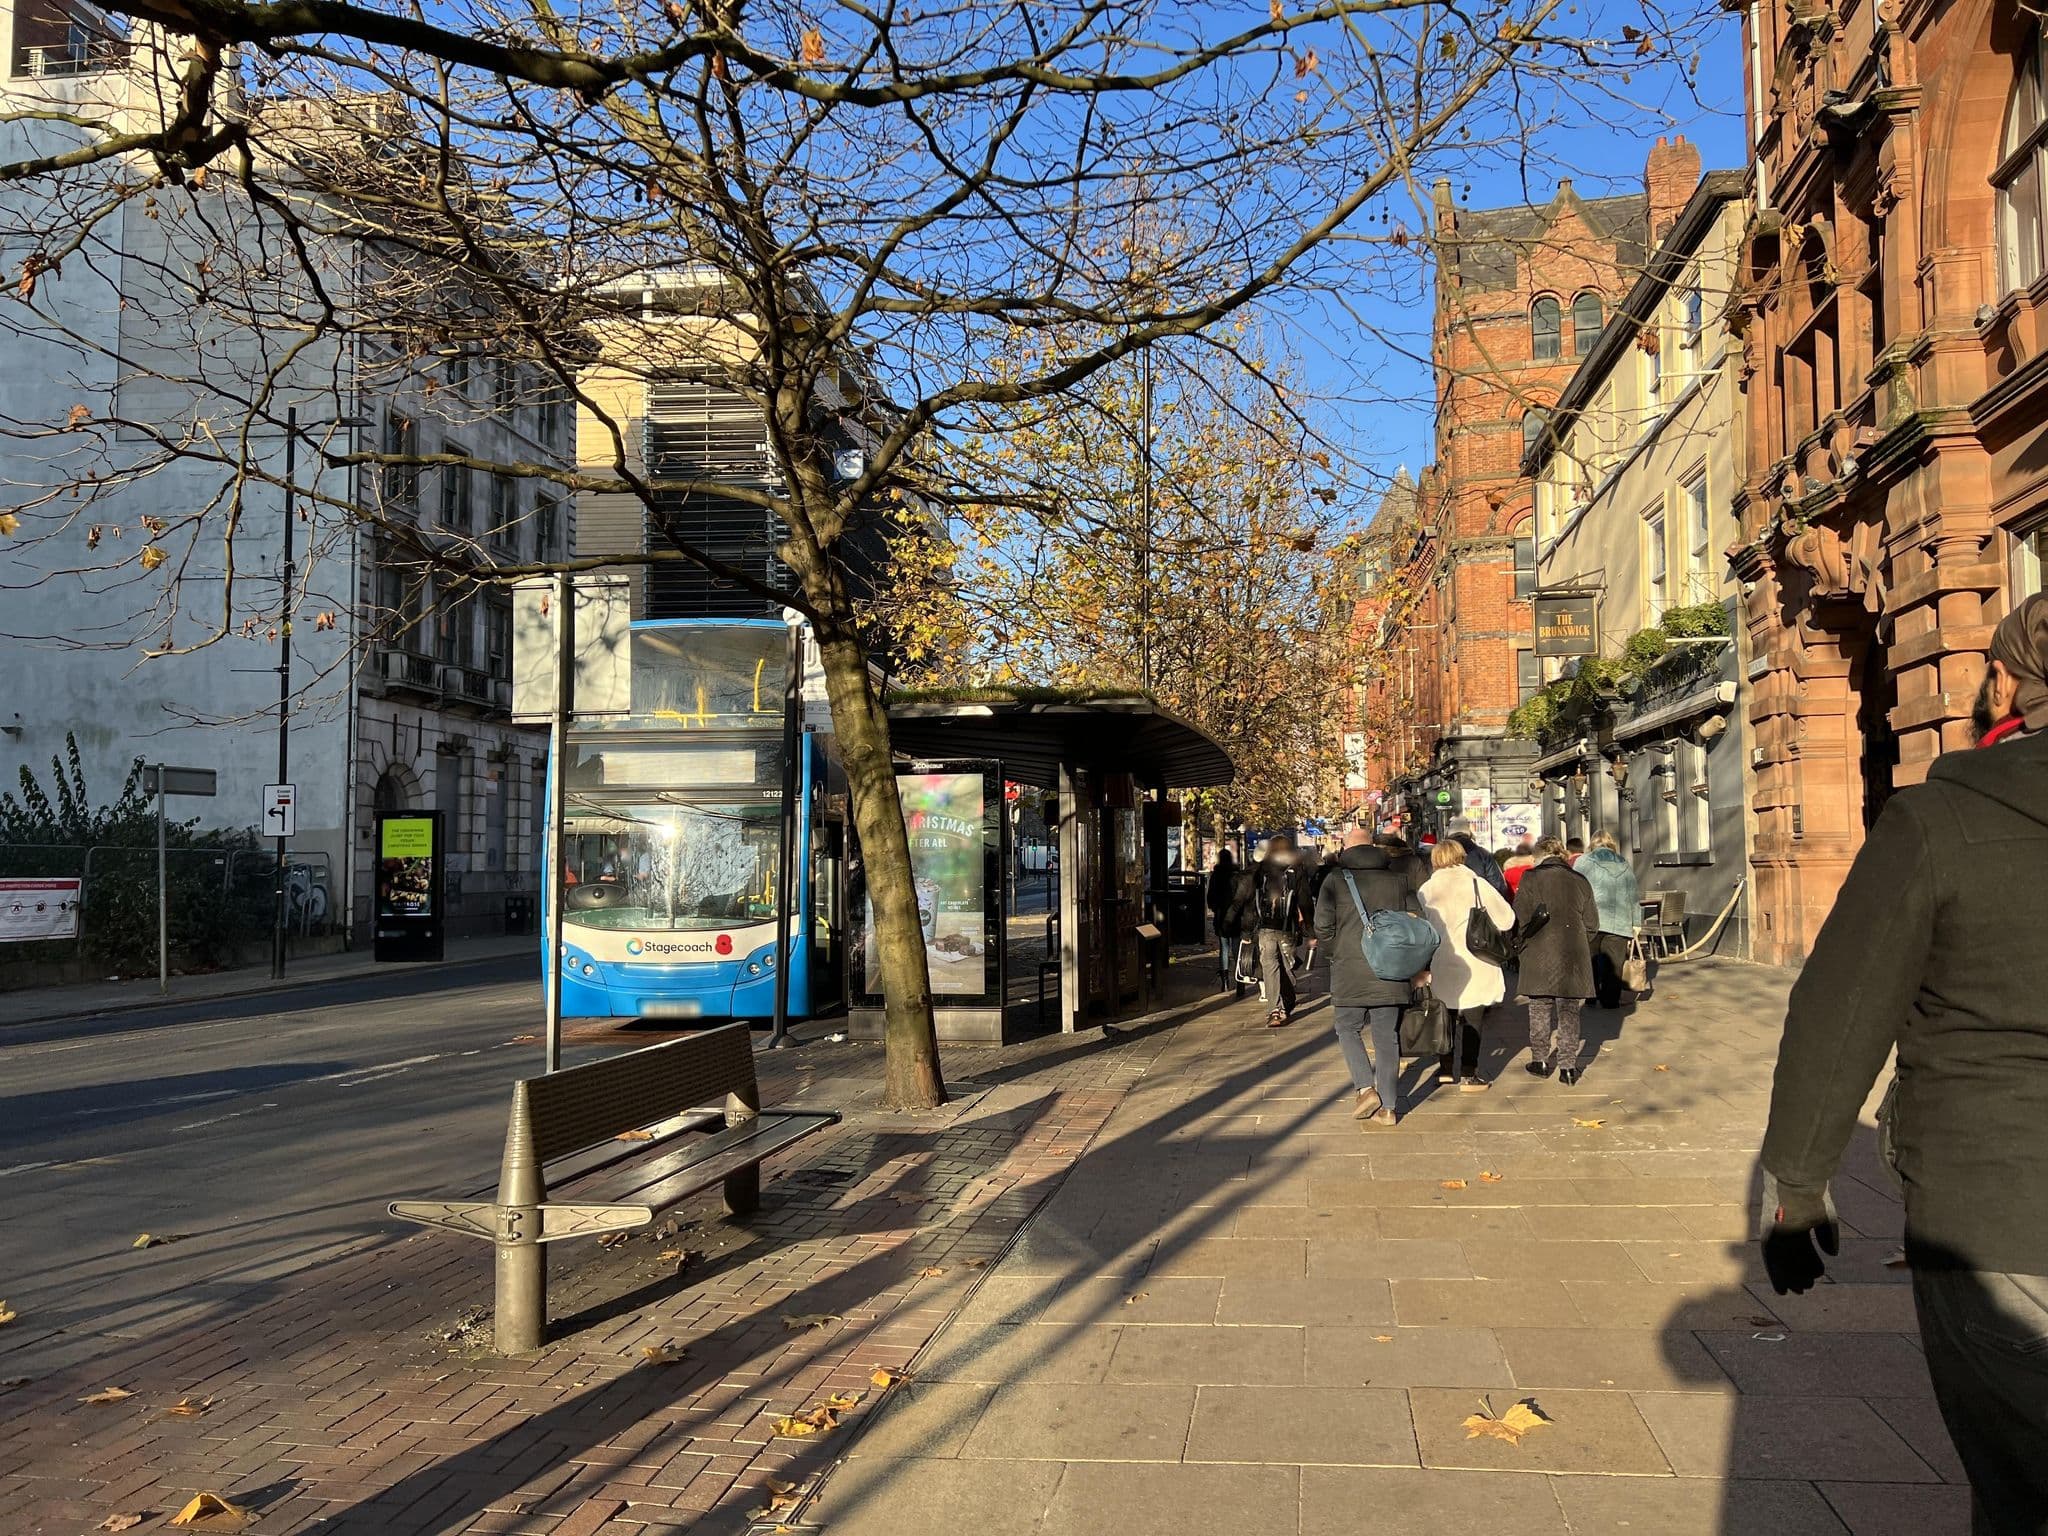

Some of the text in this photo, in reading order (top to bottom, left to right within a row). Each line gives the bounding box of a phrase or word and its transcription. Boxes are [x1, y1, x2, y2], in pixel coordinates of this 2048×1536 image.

[1556, 613, 1574, 625] THE
[1539, 624, 1590, 638] BRUNSWICK
[909, 815, 975, 837] HRISTMAS
[909, 838, 949, 848] FTER ALL
[644, 941, 713, 955] Stagecoach
